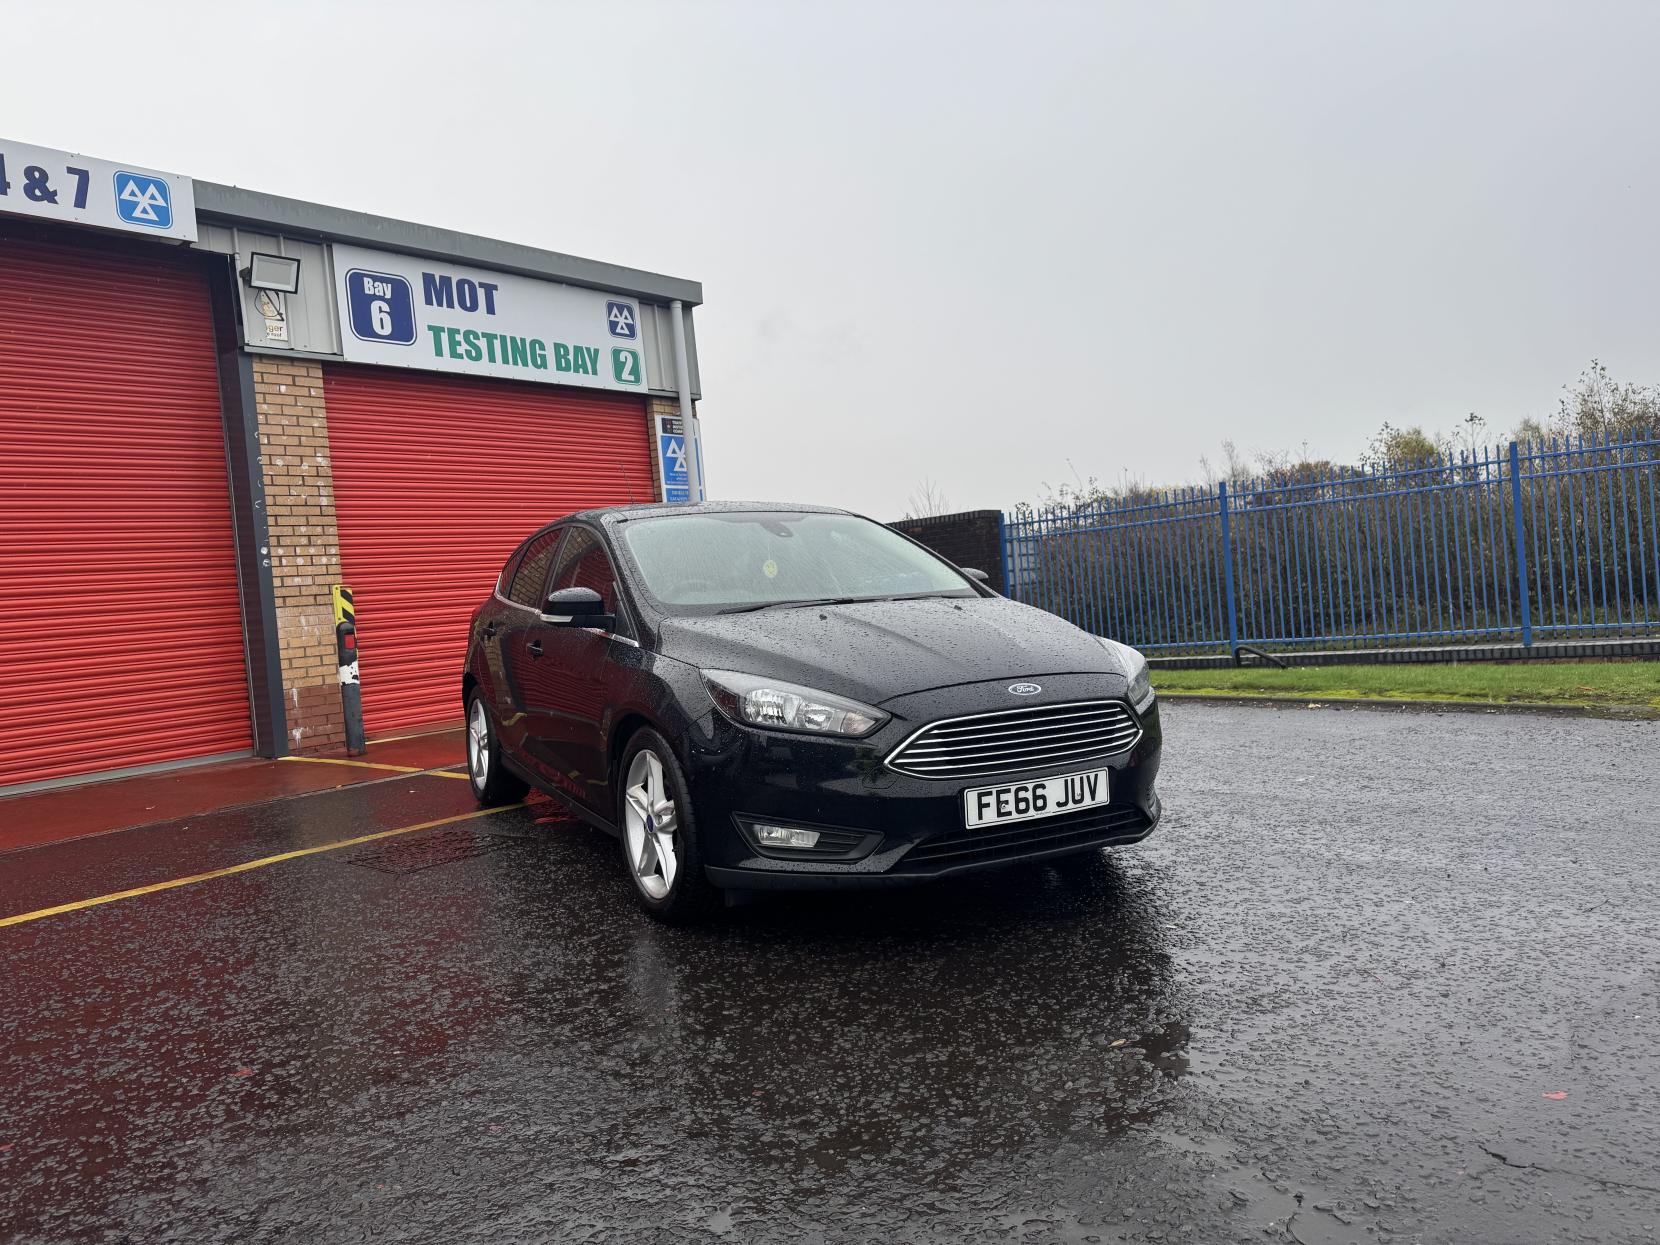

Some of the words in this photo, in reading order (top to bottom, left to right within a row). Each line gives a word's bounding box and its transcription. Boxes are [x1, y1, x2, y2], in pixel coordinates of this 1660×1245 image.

[23, 165, 59, 204] &
[66, 166, 89, 209] 7
[363, 277, 391, 298] Bay
[422, 272, 498, 315] MOT
[371, 300, 392, 336] 6
[427, 325, 547, 370] TESTING
[553, 342, 600, 376] BAY
[620, 351, 635, 381] 2
[1016, 685, 1035, 693] Ford
[977, 783, 1047, 821] FE66
[1056, 773, 1099, 808] JUV
